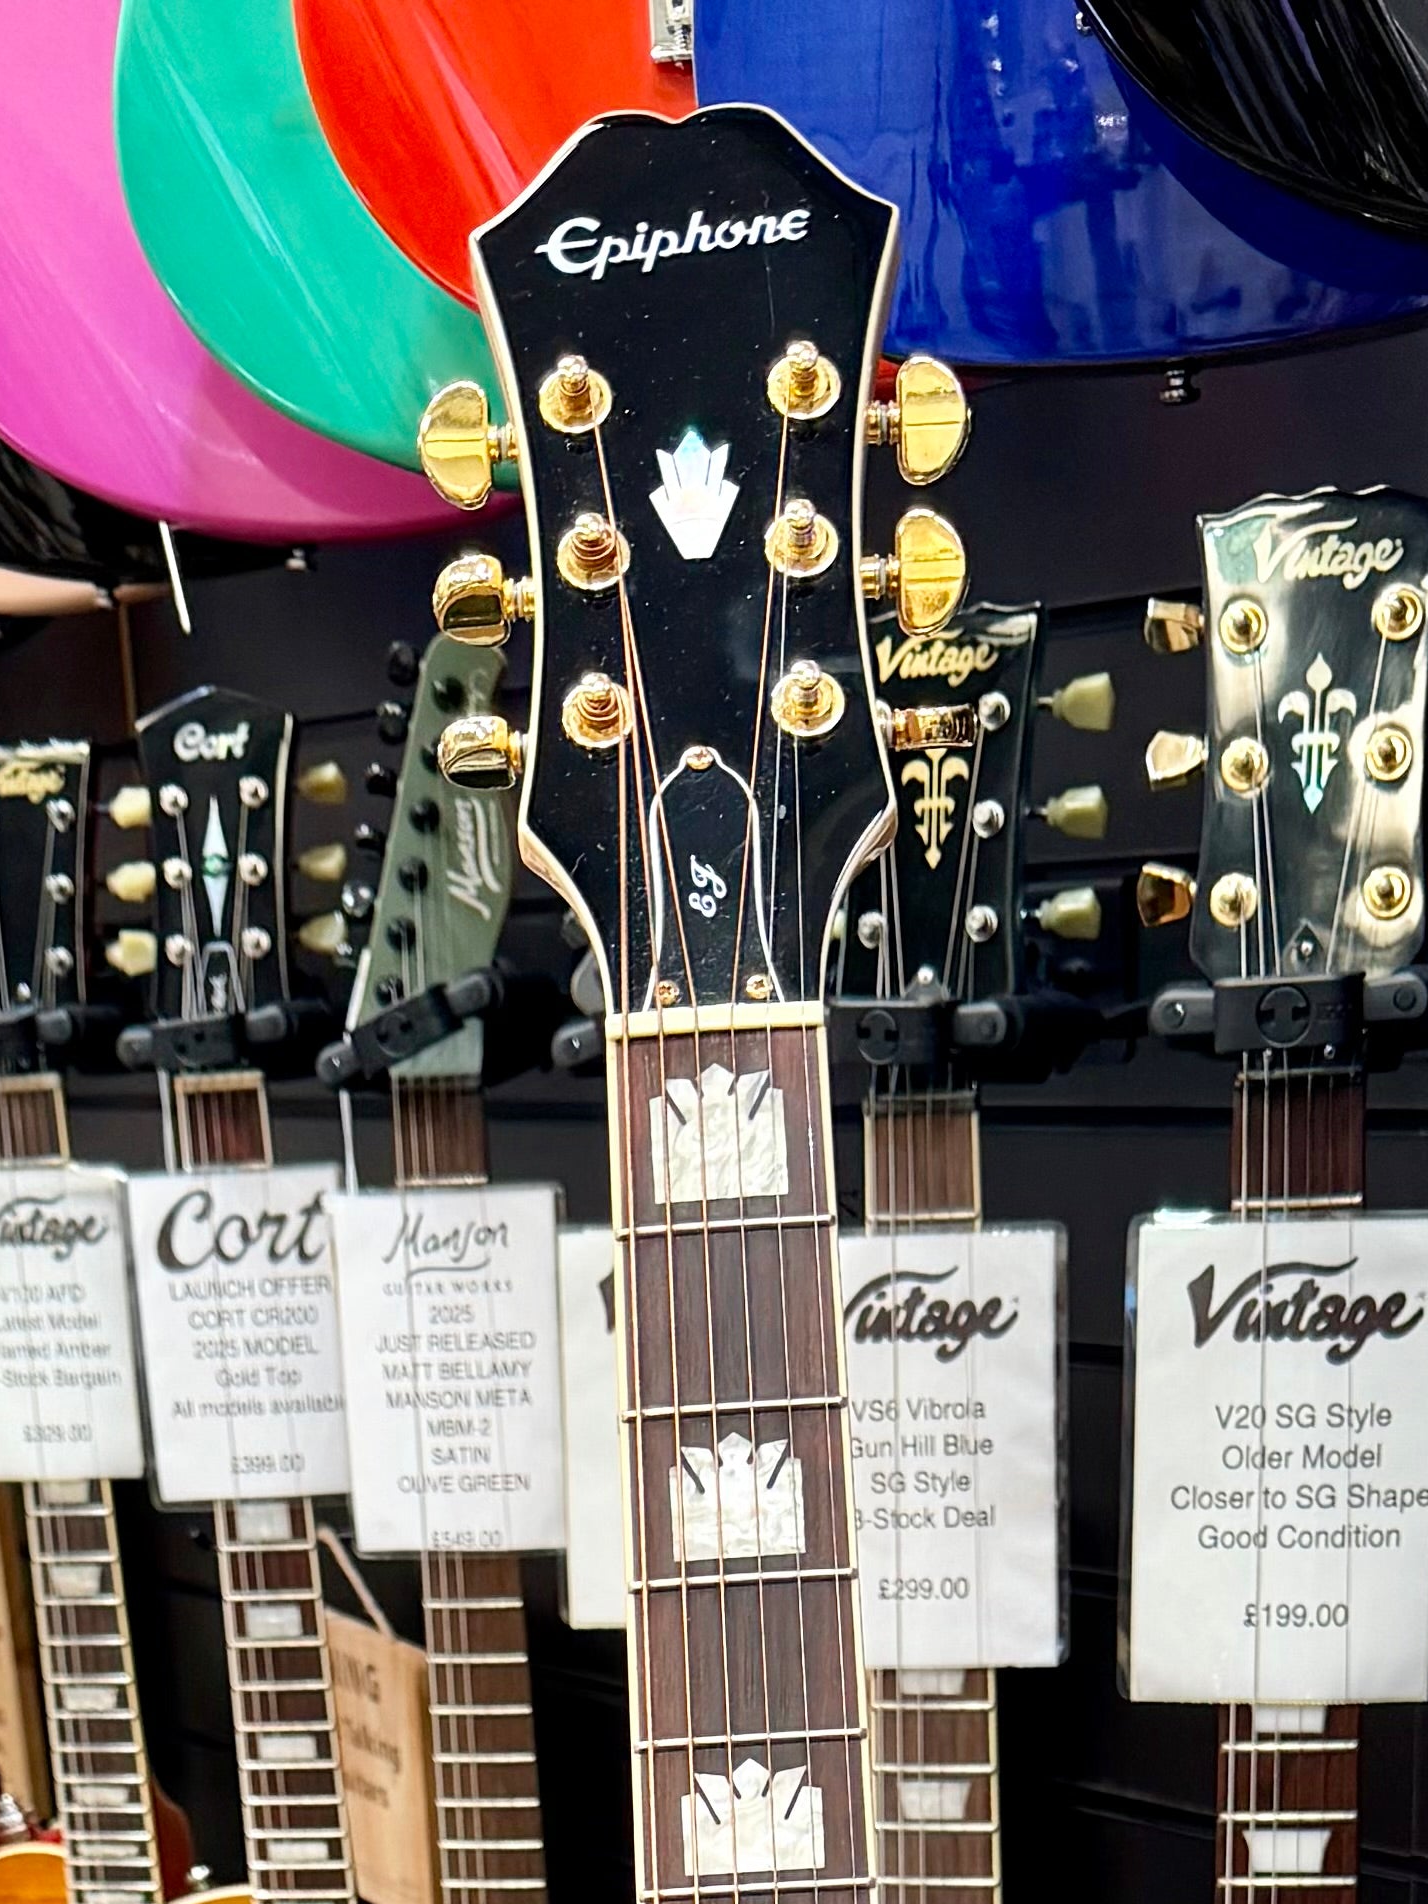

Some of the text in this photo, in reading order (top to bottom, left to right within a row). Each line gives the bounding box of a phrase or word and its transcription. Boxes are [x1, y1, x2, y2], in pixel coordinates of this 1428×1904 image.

[534, 209, 811, 281] Epiphone
[1253, 517, 1405, 590] Vintage
[875, 627, 1000, 688] Vintage
[173, 718, 251, 762] Cort
[157, 1189, 328, 1273] Cort
[382, 1211, 509, 1265] Manson
[169, 1275, 332, 1302] LAUNCH OFFER
[48, 1312, 100, 1331] Model
[188, 1305, 319, 1330] CORT CR200
[429, 1303, 475, 1325] 2025
[1187, 1257, 1424, 1366] Vintage
[193, 1334, 319, 1360] 2025 MODEL
[375, 1330, 537, 1354] JUST RELEASED
[53, 1368, 122, 1391] Bargain
[216, 1367, 302, 1388] Gold Top
[382, 1360, 532, 1381] MATT BELLAMY
[199, 1398, 265, 1418] models
[386, 1387, 532, 1410] MANSON META
[905, 1398, 987, 1421] Vibrola
[1215, 1402, 1393, 1434] V20 SG Style
[431, 1446, 490, 1467] SATIN
[850, 1433, 995, 1459] Gun Hill Blue
[1221, 1443, 1383, 1470] Older Model
[397, 1472, 531, 1495] OLIVE GREEN
[871, 1470, 972, 1498] SG Style
[1170, 1485, 1255, 1511] Closer
[1262, 1486, 1287, 1510] to
[1295, 1483, 1337, 1510] SG
[943, 1505, 996, 1529] Deal
[1197, 1524, 1402, 1550] Good Condition
[877, 1577, 970, 1602] £299.00
[1243, 1602, 1350, 1629] £199.00
